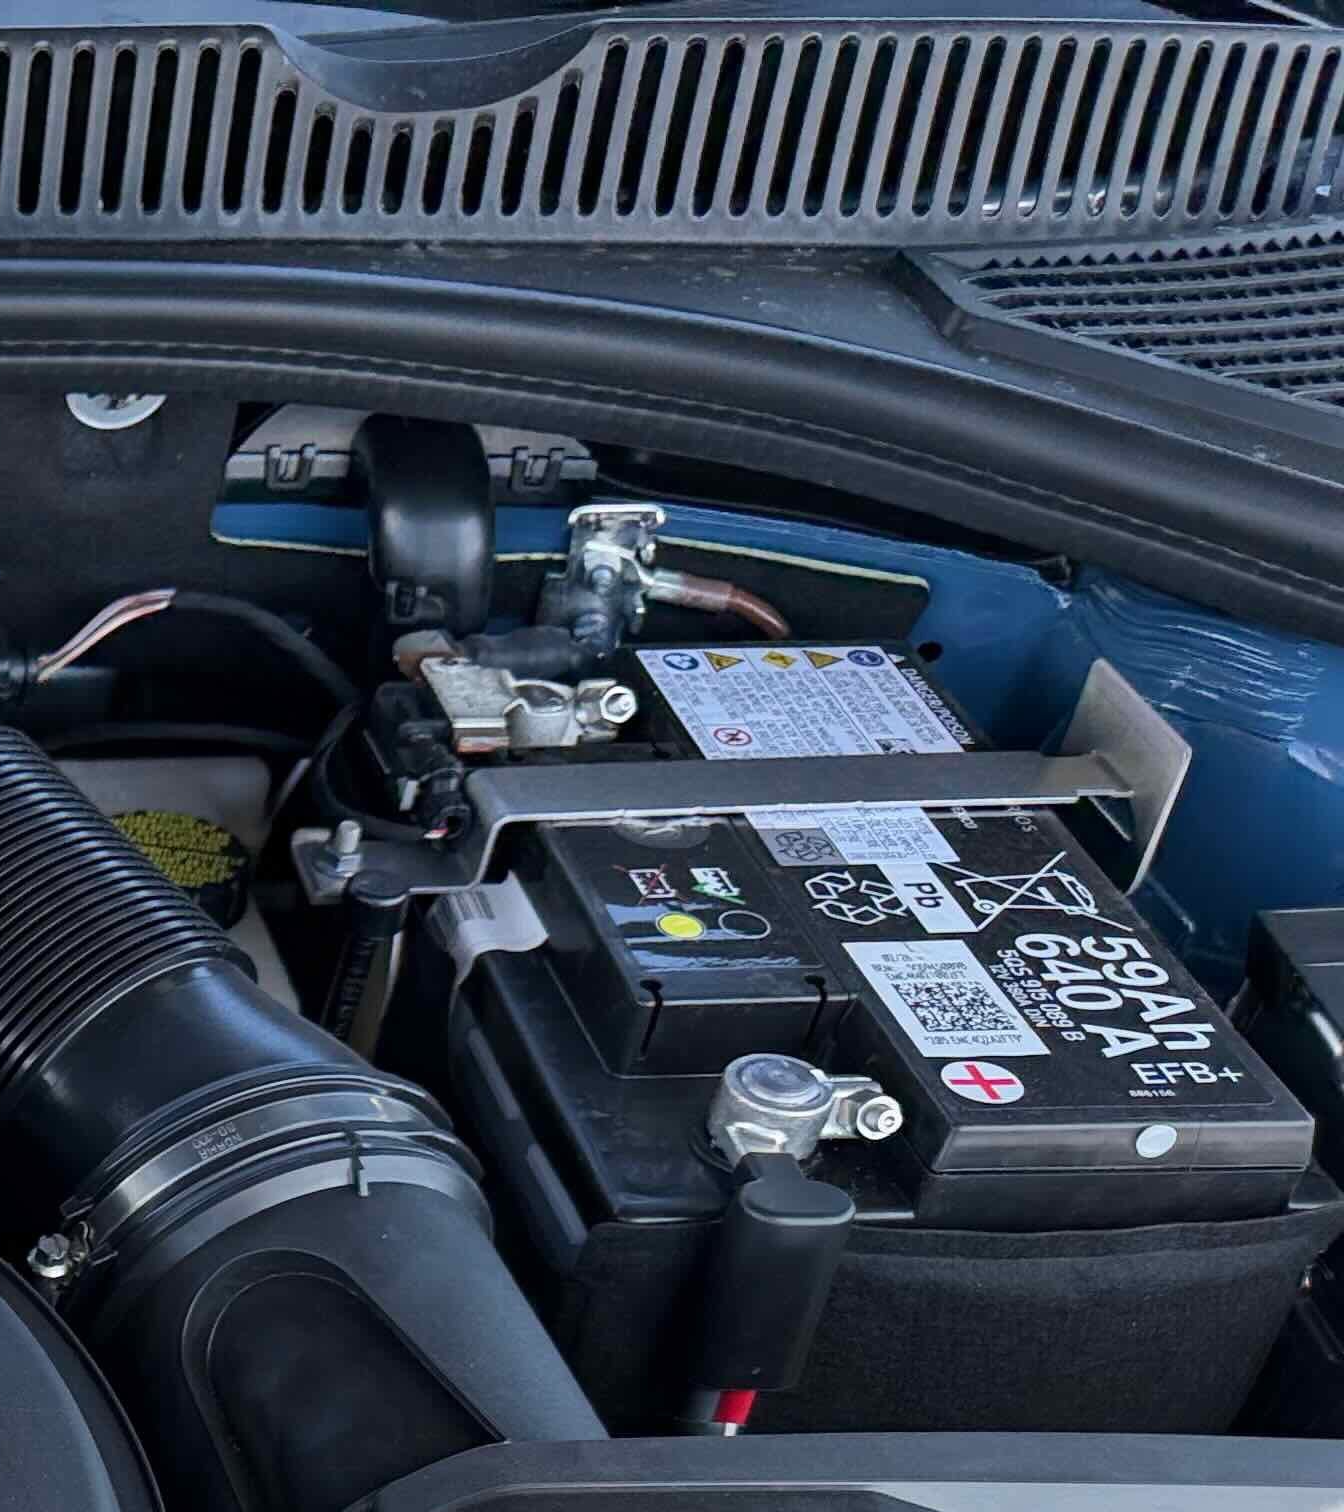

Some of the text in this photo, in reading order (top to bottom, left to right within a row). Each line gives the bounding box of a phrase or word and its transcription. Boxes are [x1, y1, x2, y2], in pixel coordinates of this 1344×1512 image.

[904, 881, 943, 910] Pb
[1015, 932, 1159, 1059] 640 A
[1081, 935, 1215, 1051] 59Ah
[1130, 1062, 1244, 1085] EFB+
